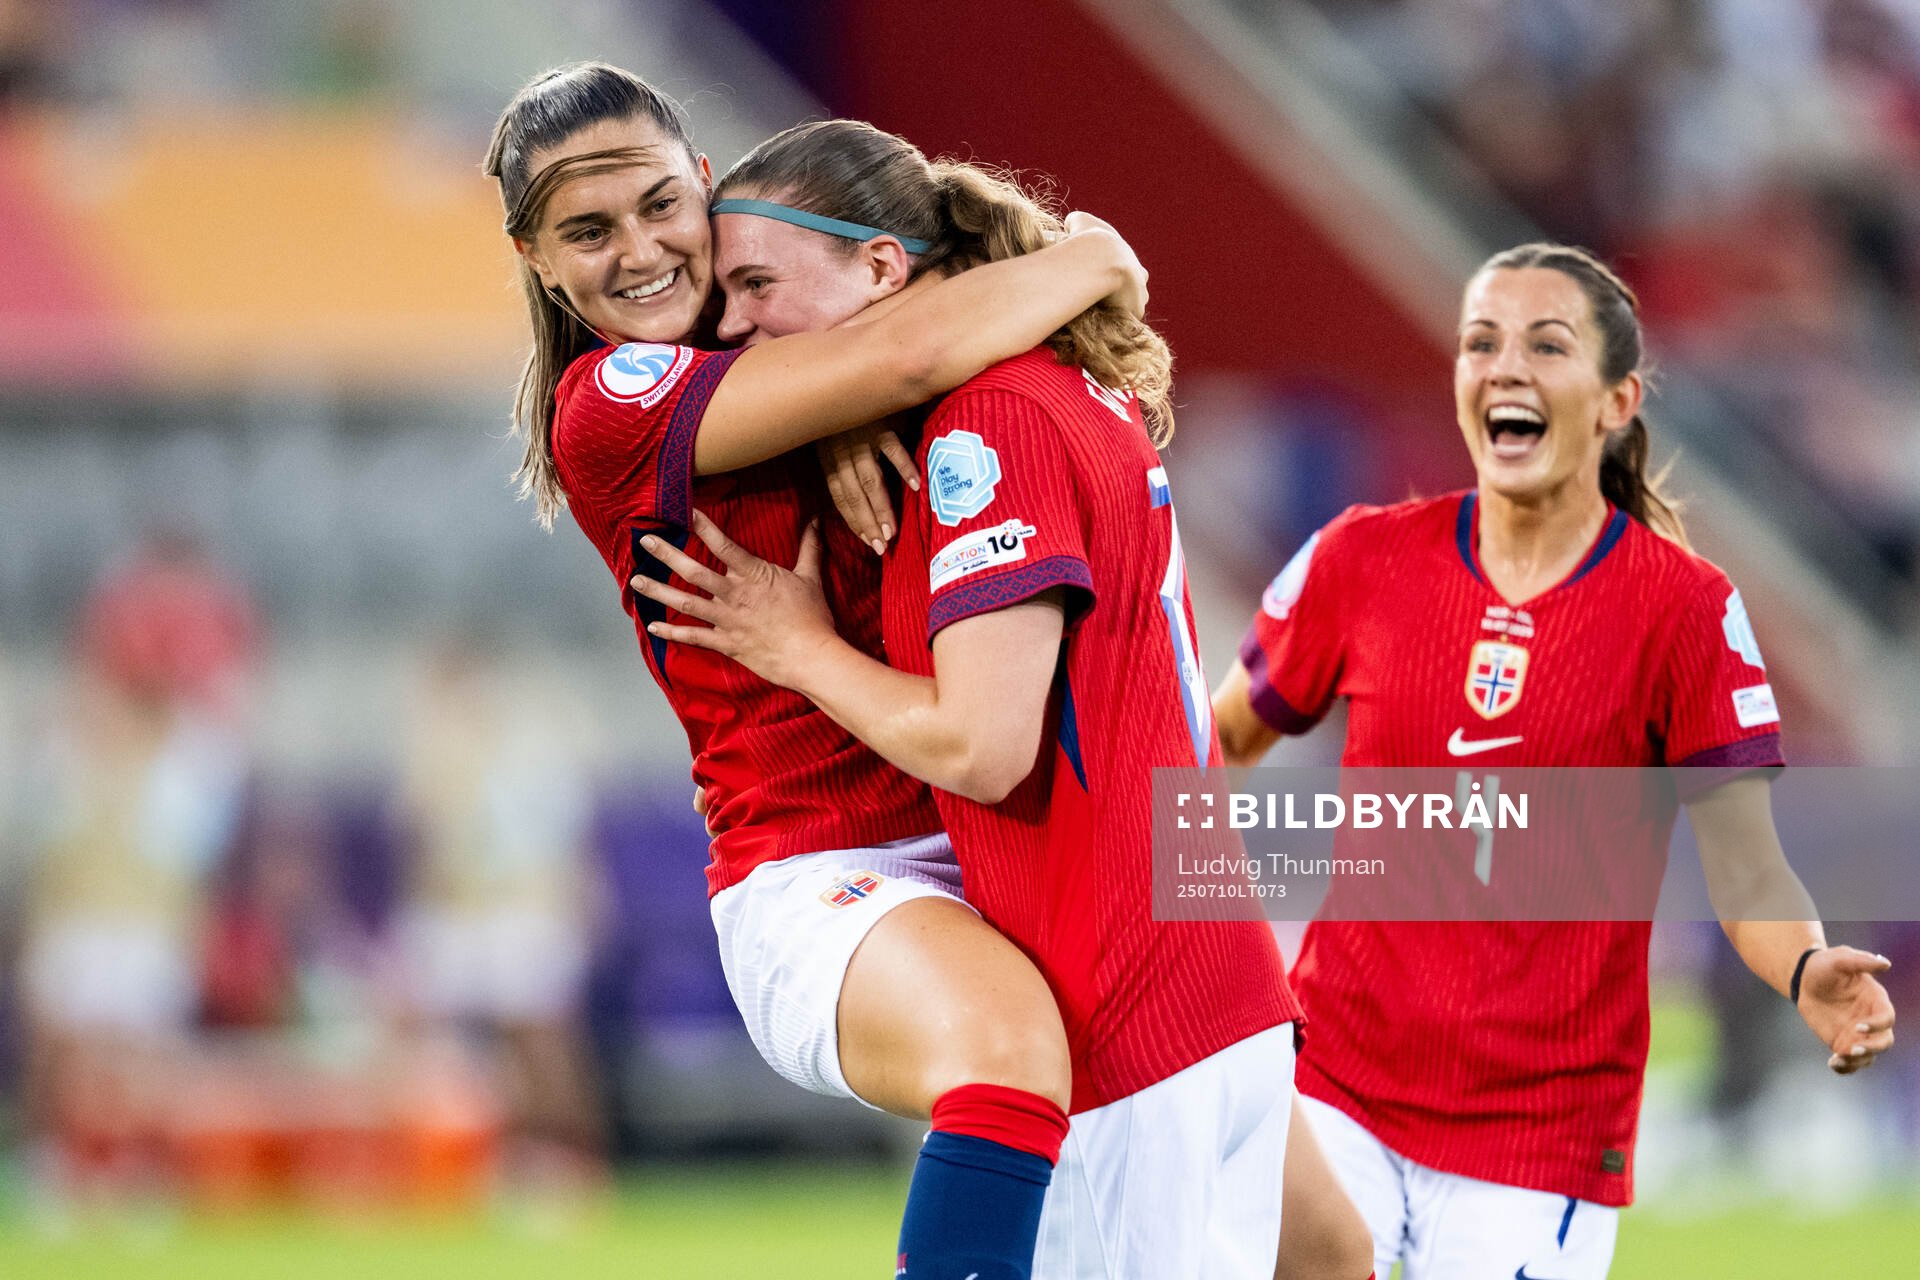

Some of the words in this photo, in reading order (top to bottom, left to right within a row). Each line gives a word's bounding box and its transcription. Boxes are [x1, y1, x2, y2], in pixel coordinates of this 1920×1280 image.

[643, 362, 686, 405] SWITZERLAND
[938, 465, 951, 475] We
[943, 479, 973, 497] Strong
[987, 533, 1018, 555] 10
